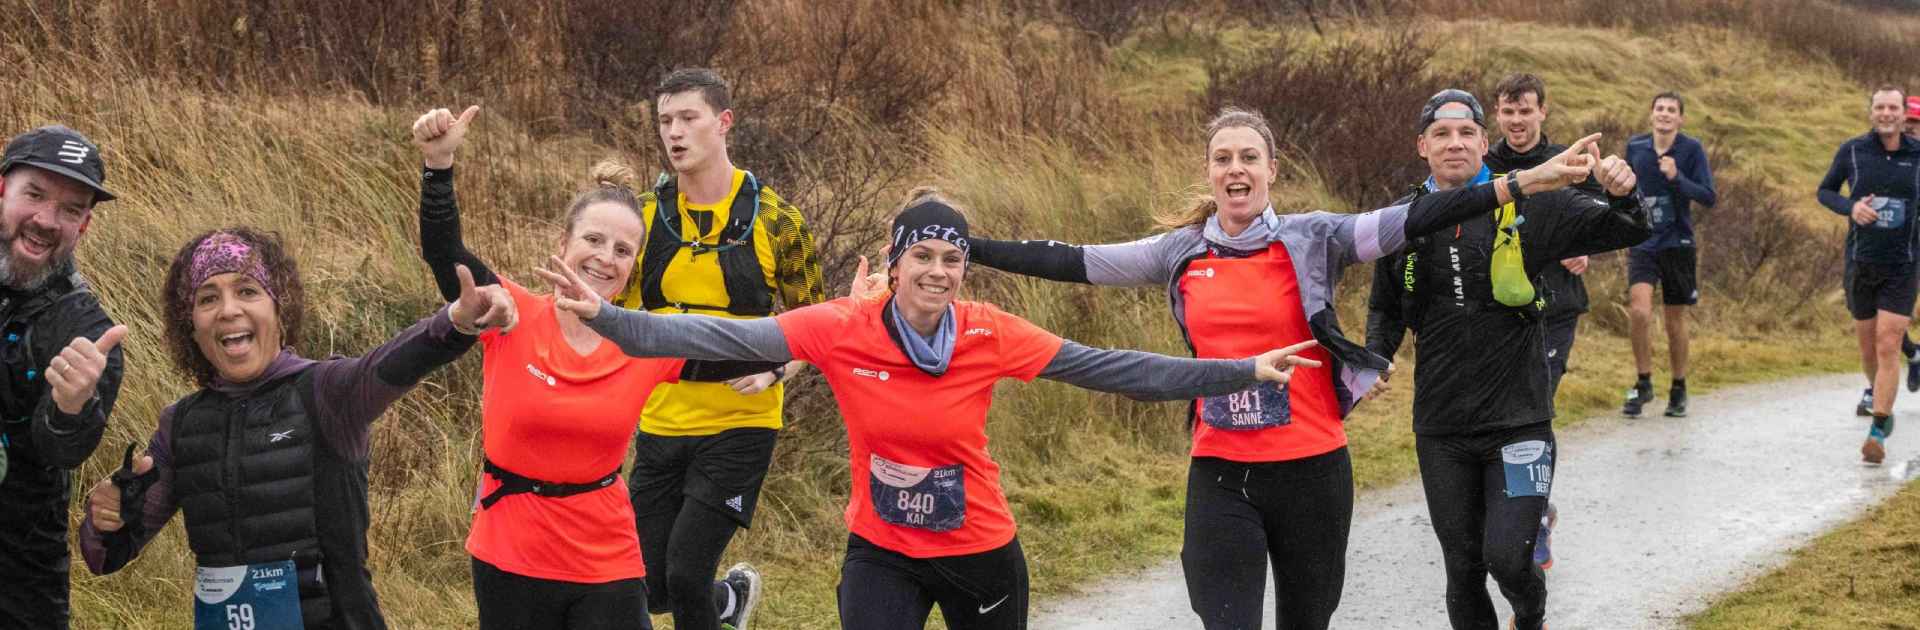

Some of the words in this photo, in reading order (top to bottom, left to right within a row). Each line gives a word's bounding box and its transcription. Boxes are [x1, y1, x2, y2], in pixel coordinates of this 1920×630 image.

[1228, 390, 1260, 413] 841
[1231, 412, 1264, 426] SANNE
[897, 490, 935, 514] 840
[906, 512, 924, 525] KAI
[252, 568, 284, 579] 21km
[226, 603, 255, 630] 59
